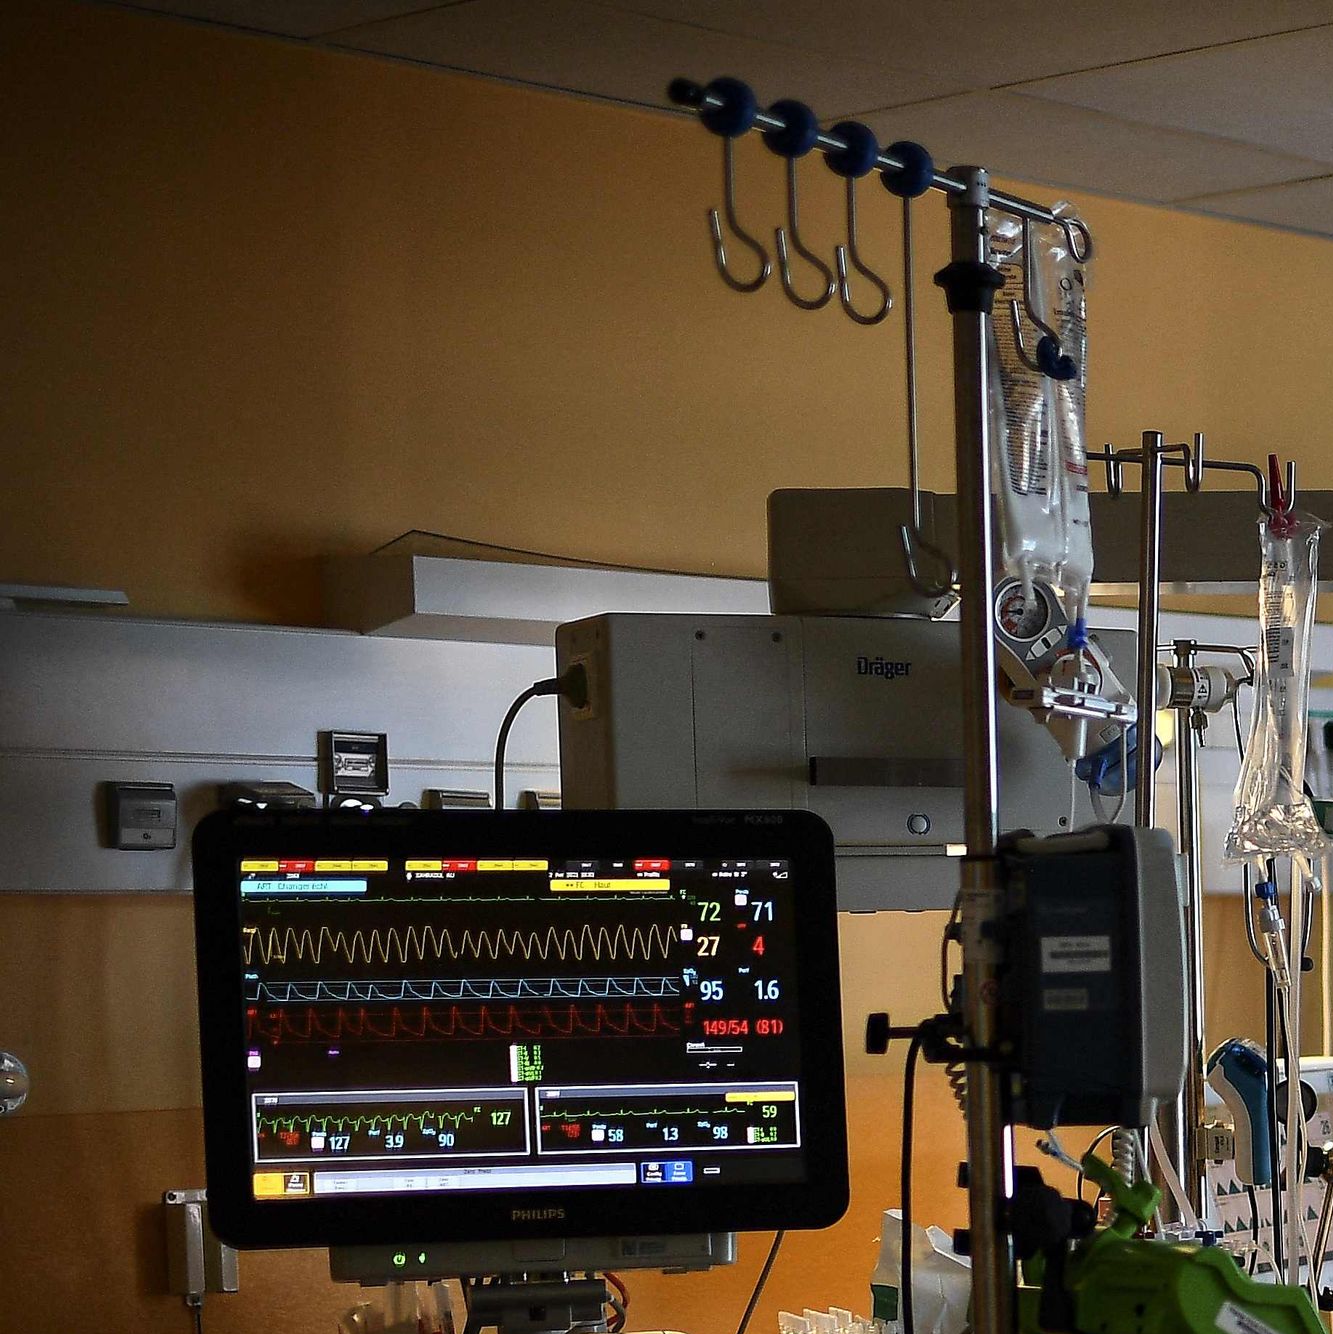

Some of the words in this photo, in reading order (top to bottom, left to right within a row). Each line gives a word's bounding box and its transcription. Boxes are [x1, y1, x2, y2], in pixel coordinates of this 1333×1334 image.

[857, 656, 913, 680] Dräger
[697, 902, 721, 921] 72
[750, 902, 773, 921] 71
[697, 936, 720, 957] 27
[752, 936, 765, 956] 4
[700, 980, 724, 1001] 95
[753, 980, 780, 1000] 1.6
[703, 1020, 749, 1035] 149/54
[756, 1019, 784, 1035] (81)
[490, 1111, 511, 1126] 127
[761, 1105, 778, 1118] 59
[438, 1134, 455, 1147] 90
[607, 1128, 624, 1142] 58
[712, 1126, 728, 1139] 98
[329, 1135, 350, 1149] 127
[512, 1208, 565, 1221] PHILIPS
